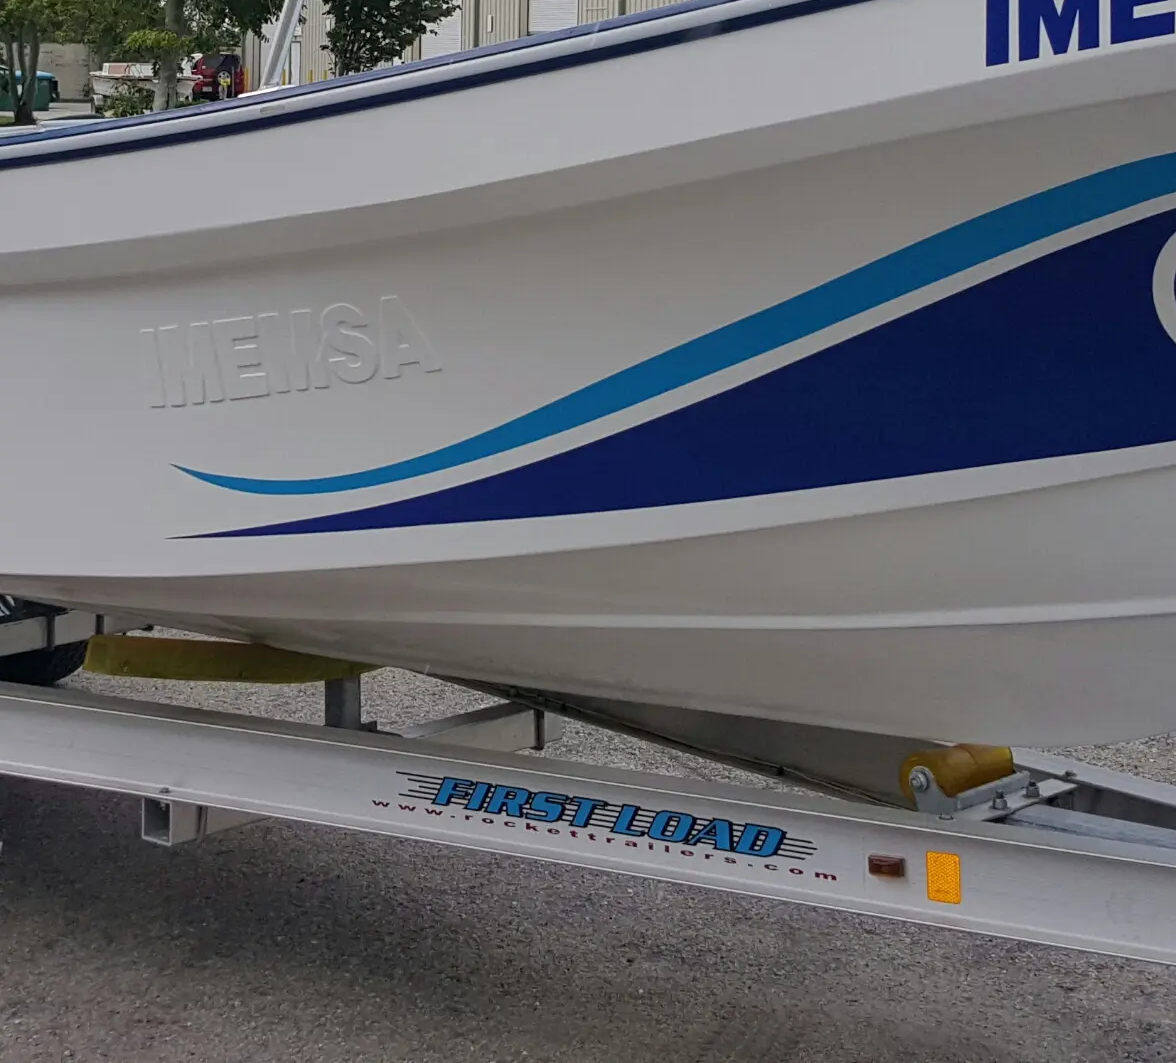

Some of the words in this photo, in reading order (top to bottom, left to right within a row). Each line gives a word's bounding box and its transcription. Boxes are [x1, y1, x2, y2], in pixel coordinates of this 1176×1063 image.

[139, 294, 444, 409] IMEMSA
[371, 799, 838, 881] www.rockettrailers.com
[431, 776, 609, 828] FIRST
[609, 803, 787, 858] LOAD
